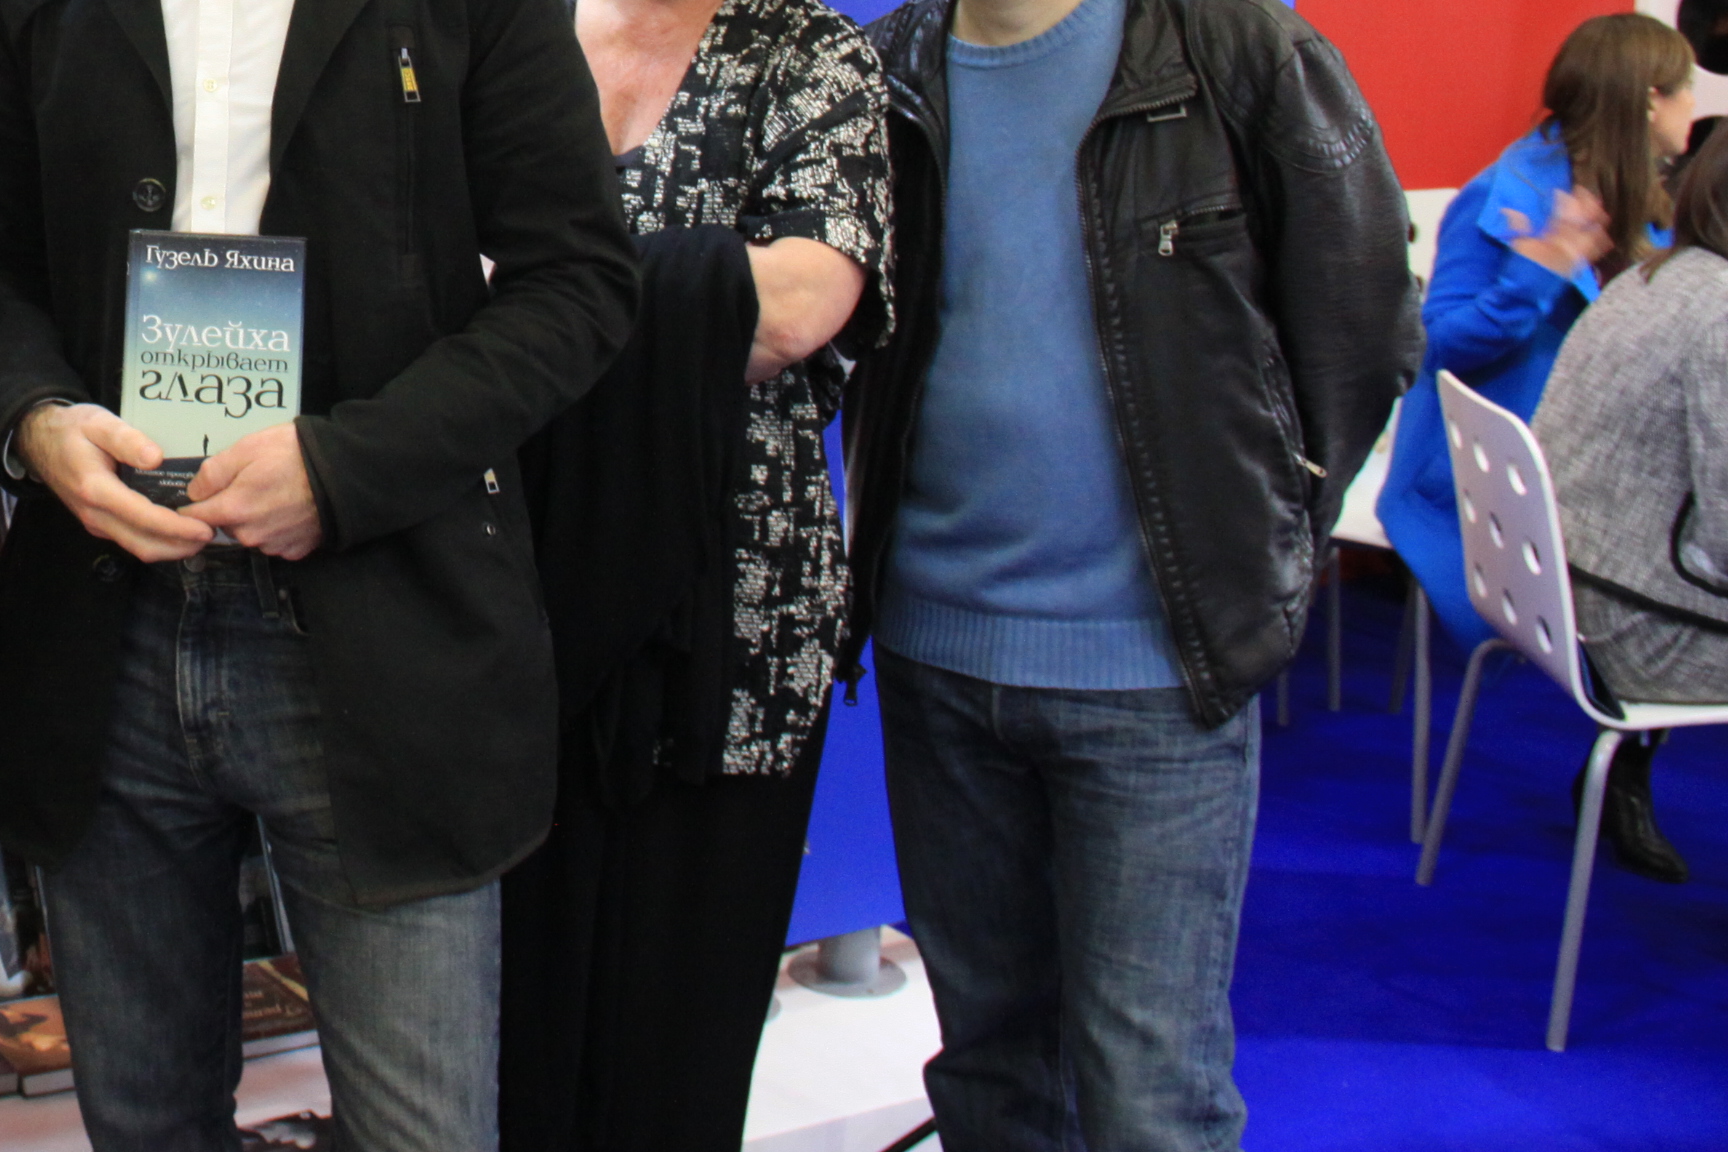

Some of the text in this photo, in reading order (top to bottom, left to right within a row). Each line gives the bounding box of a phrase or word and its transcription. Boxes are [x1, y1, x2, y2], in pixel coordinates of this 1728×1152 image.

[145, 245, 295, 272] Гузель Яхина
[141, 314, 290, 352] Зулейха
[140, 349, 288, 373] открывает
[139, 369, 287, 419] глаза
